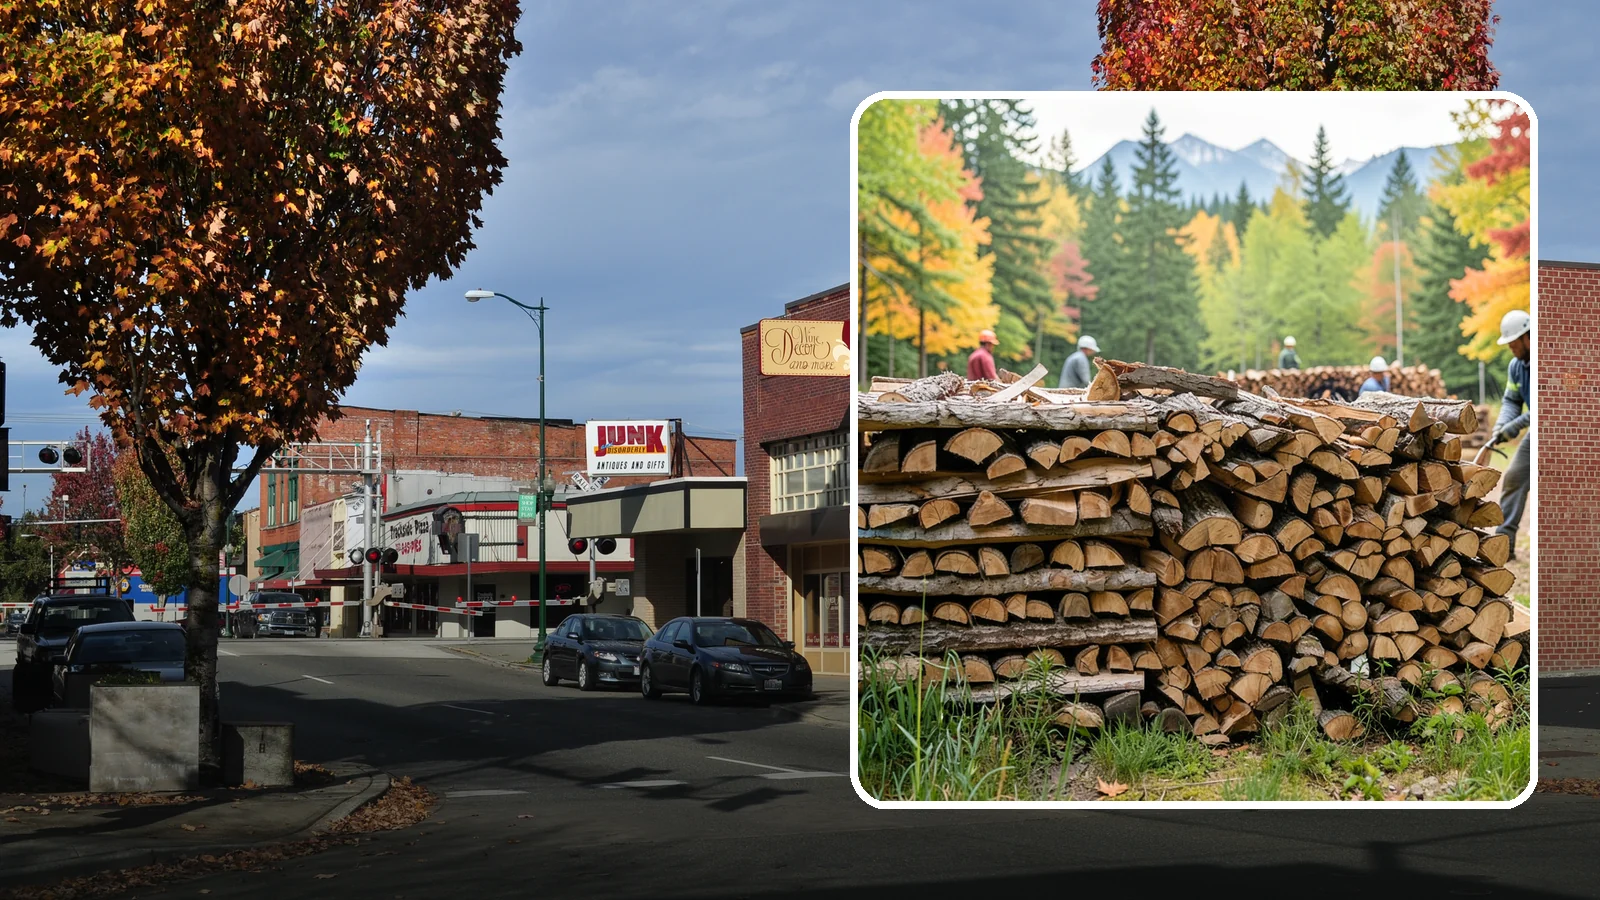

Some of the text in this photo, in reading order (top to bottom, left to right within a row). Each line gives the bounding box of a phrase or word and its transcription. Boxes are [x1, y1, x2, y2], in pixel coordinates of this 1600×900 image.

[595, 425, 665, 457] JUNK
[607, 446, 646, 454] DISORDERLY
[597, 460, 665, 470] ANTIQUES AND GIFTS
[573, 473, 587, 491] RAIL
[590, 476, 608, 491] SING
[352, 498, 364, 511] CRO
[414, 519, 429, 535] Pizza
